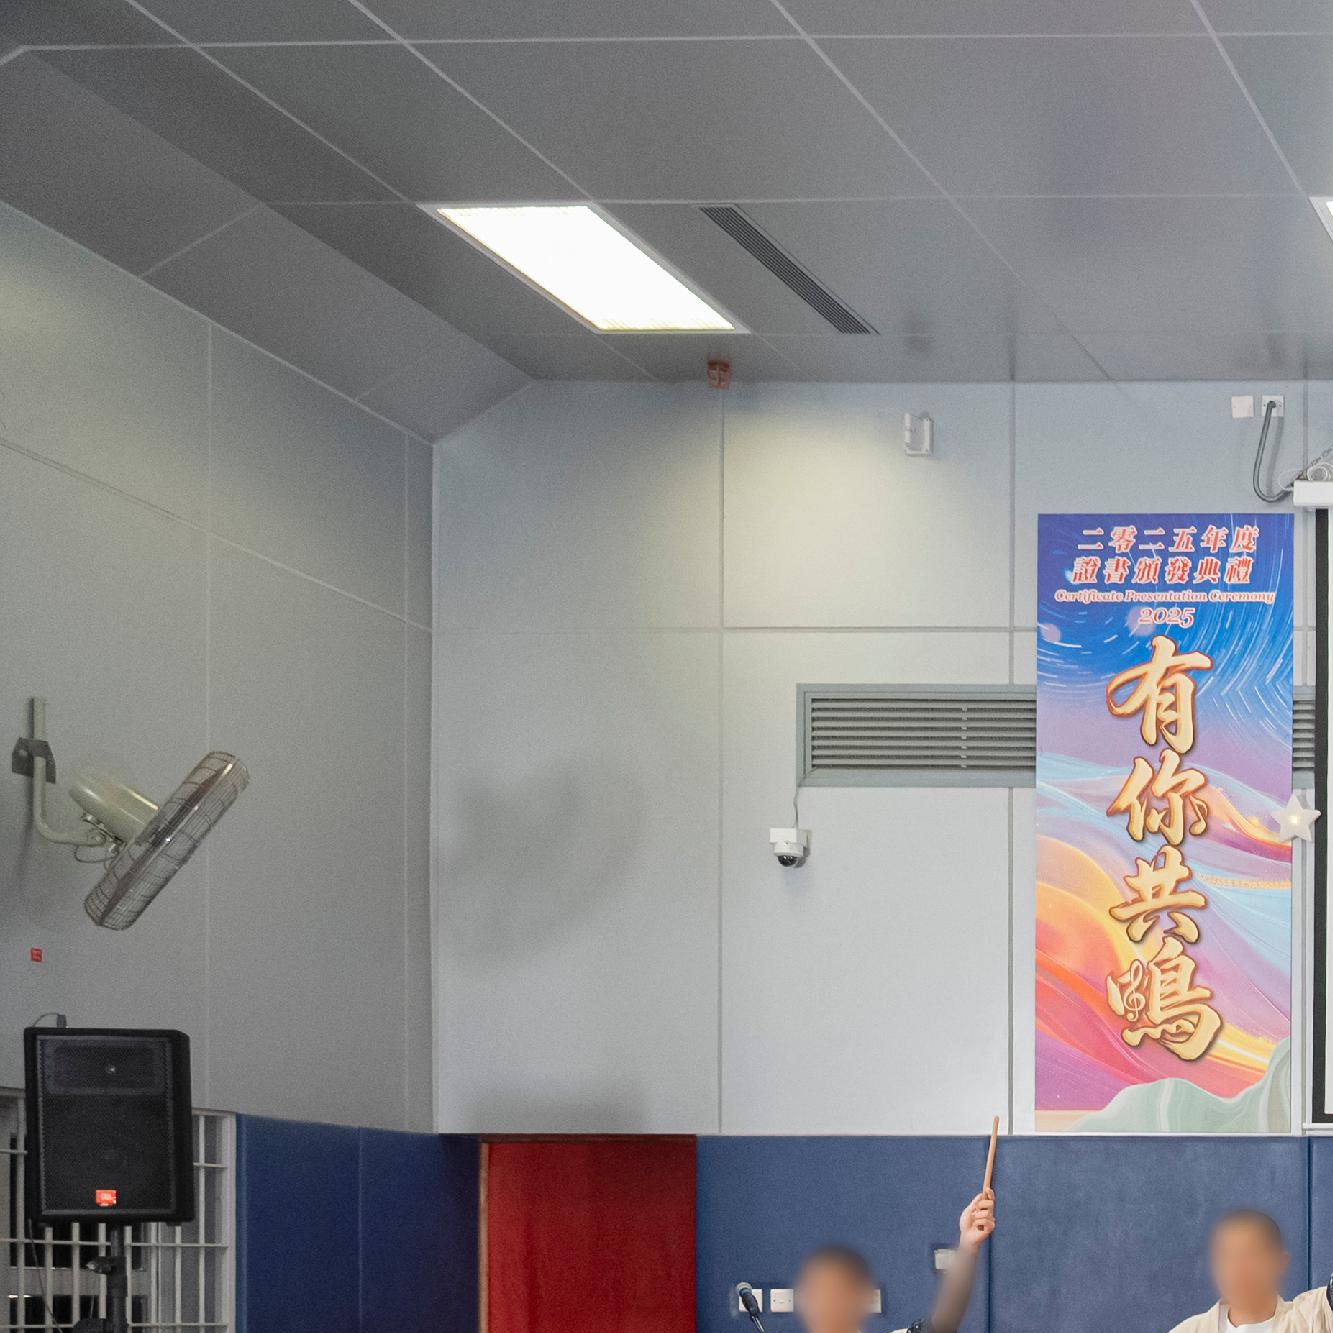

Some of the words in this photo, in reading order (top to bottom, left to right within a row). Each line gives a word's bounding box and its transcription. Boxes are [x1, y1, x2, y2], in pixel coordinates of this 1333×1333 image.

[1077, 525, 1260, 553] 二零二五年度
[1071, 557, 1254, 584] 證書頒發典禮
[1055, 589, 1123, 604] Certificate
[1125, 589, 1208, 602] Presentation
[1209, 590, 1276, 604] Ceremony
[1138, 607, 1196, 627] 2025
